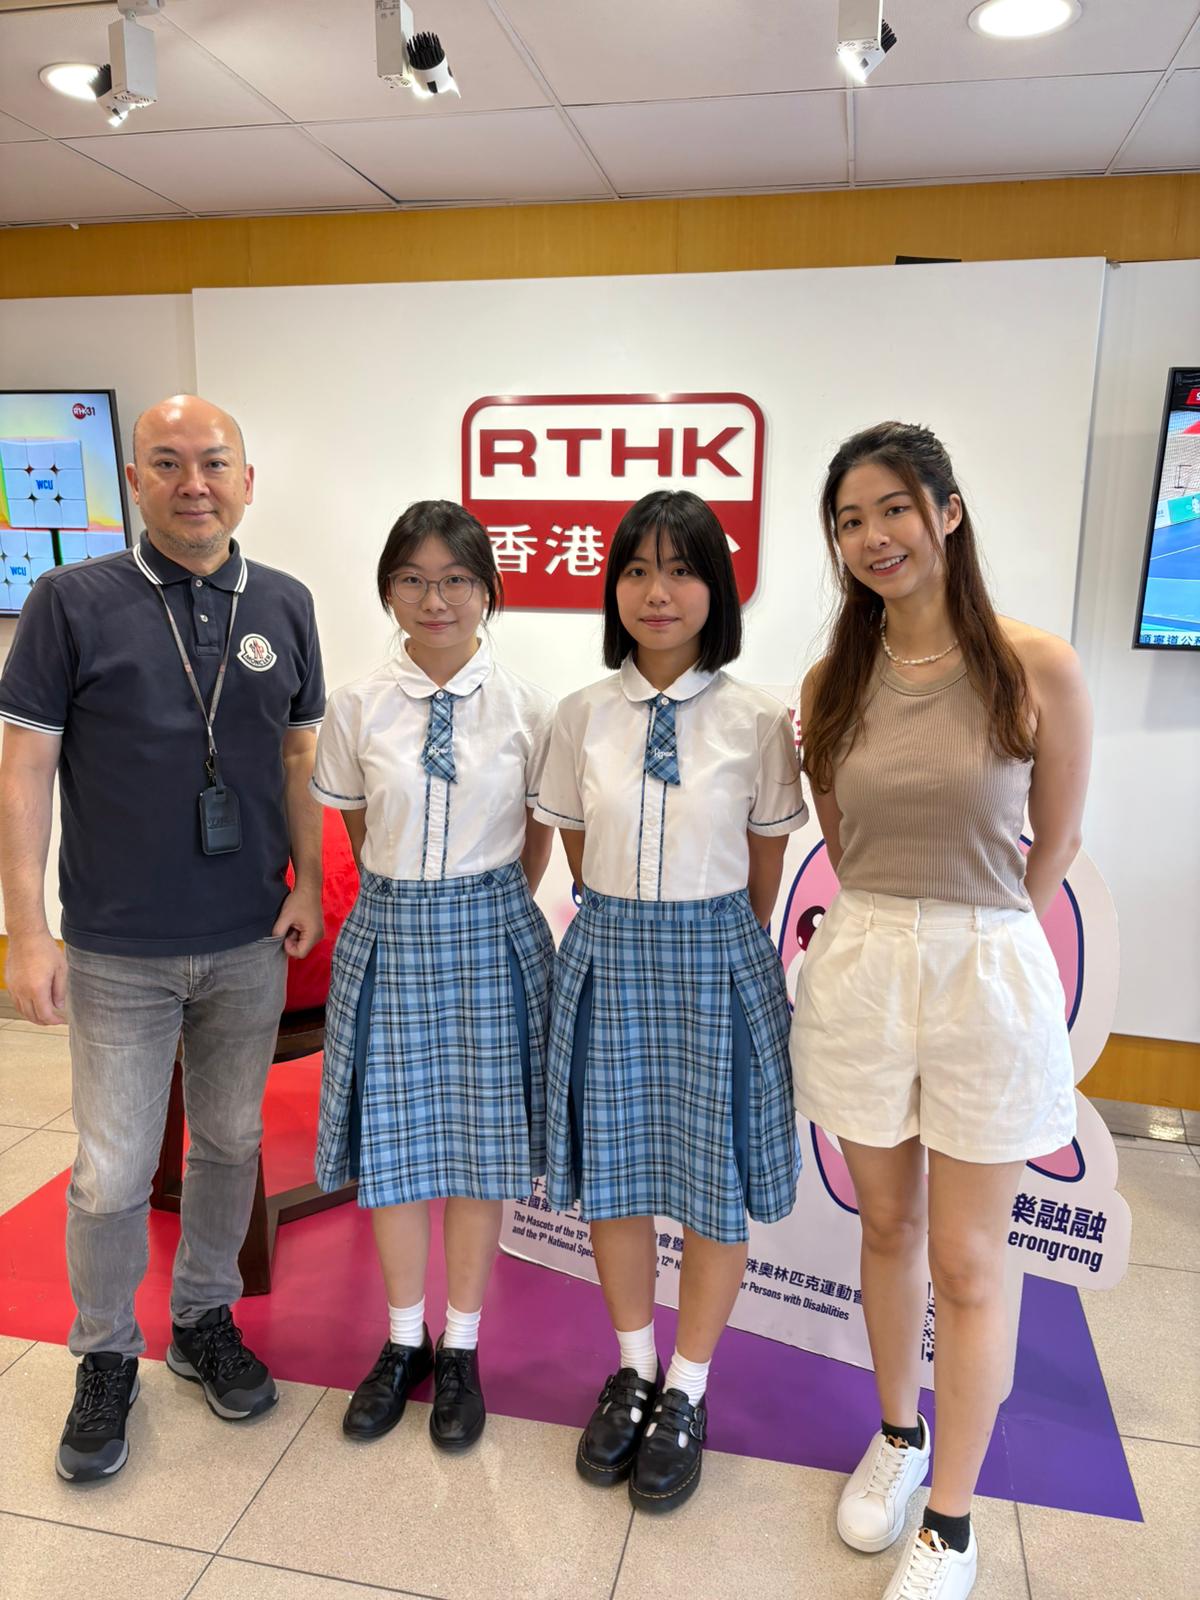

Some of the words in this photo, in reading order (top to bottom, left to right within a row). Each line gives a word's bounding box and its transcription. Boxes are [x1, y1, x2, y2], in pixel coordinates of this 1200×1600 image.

[479, 427, 744, 477] RTHK
[35, 479, 54, 490] WCU
[10, 566, 27, 577] WCU
[514, 1211, 525, 1222] The
[527, 1215, 554, 1231] Mascots
[555, 1225, 563, 1233] of
[563, 1227, 575, 1238] the
[576, 1230, 588, 1241] 15th
[1011, 1192, 1107, 1243] 樂融融
[1007, 1230, 1103, 1272] erongrong
[512, 1226, 525, 1236] and
[526, 1229, 537, 1239] the
[548, 1235, 577, 1252] National
[577, 1243, 595, 1258] Spec
[749, 1282, 782, 1300] Persons
[783, 1293, 802, 1307] with
[802, 1297, 850, 1321] Disabilities
